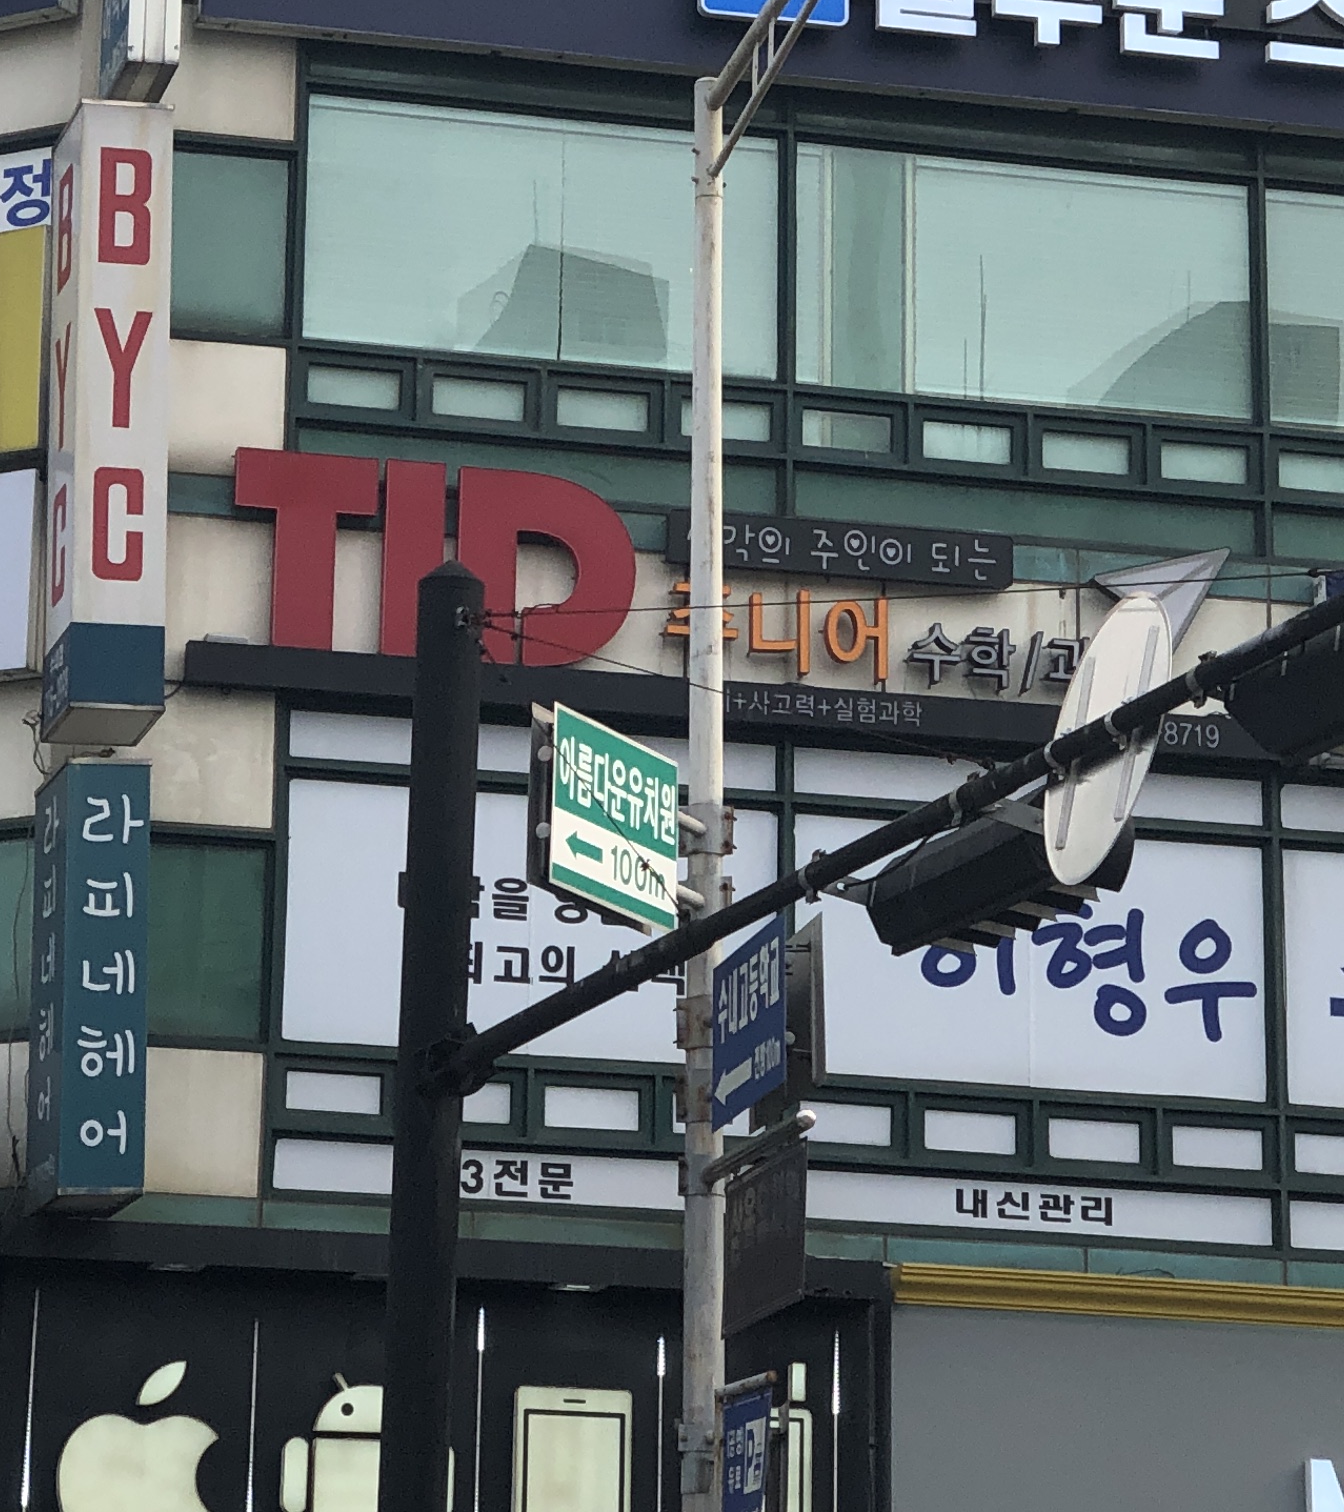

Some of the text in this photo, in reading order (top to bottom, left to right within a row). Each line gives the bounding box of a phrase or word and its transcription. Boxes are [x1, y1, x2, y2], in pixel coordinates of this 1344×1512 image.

[91, 147, 154, 582] BYC
[234, 446, 637, 668] TID
[809, 527, 998, 583] 주인이 되는
[665, 581, 890, 682] 주니어
[610, 844, 667, 901] 100m
[77, 792, 146, 1156] 라피네헤어
[717, 935, 781, 1045] 수내고등학교
[920, 902, 1258, 1043] 이형우
[954, 1186, 1115, 1227] 내신관리
